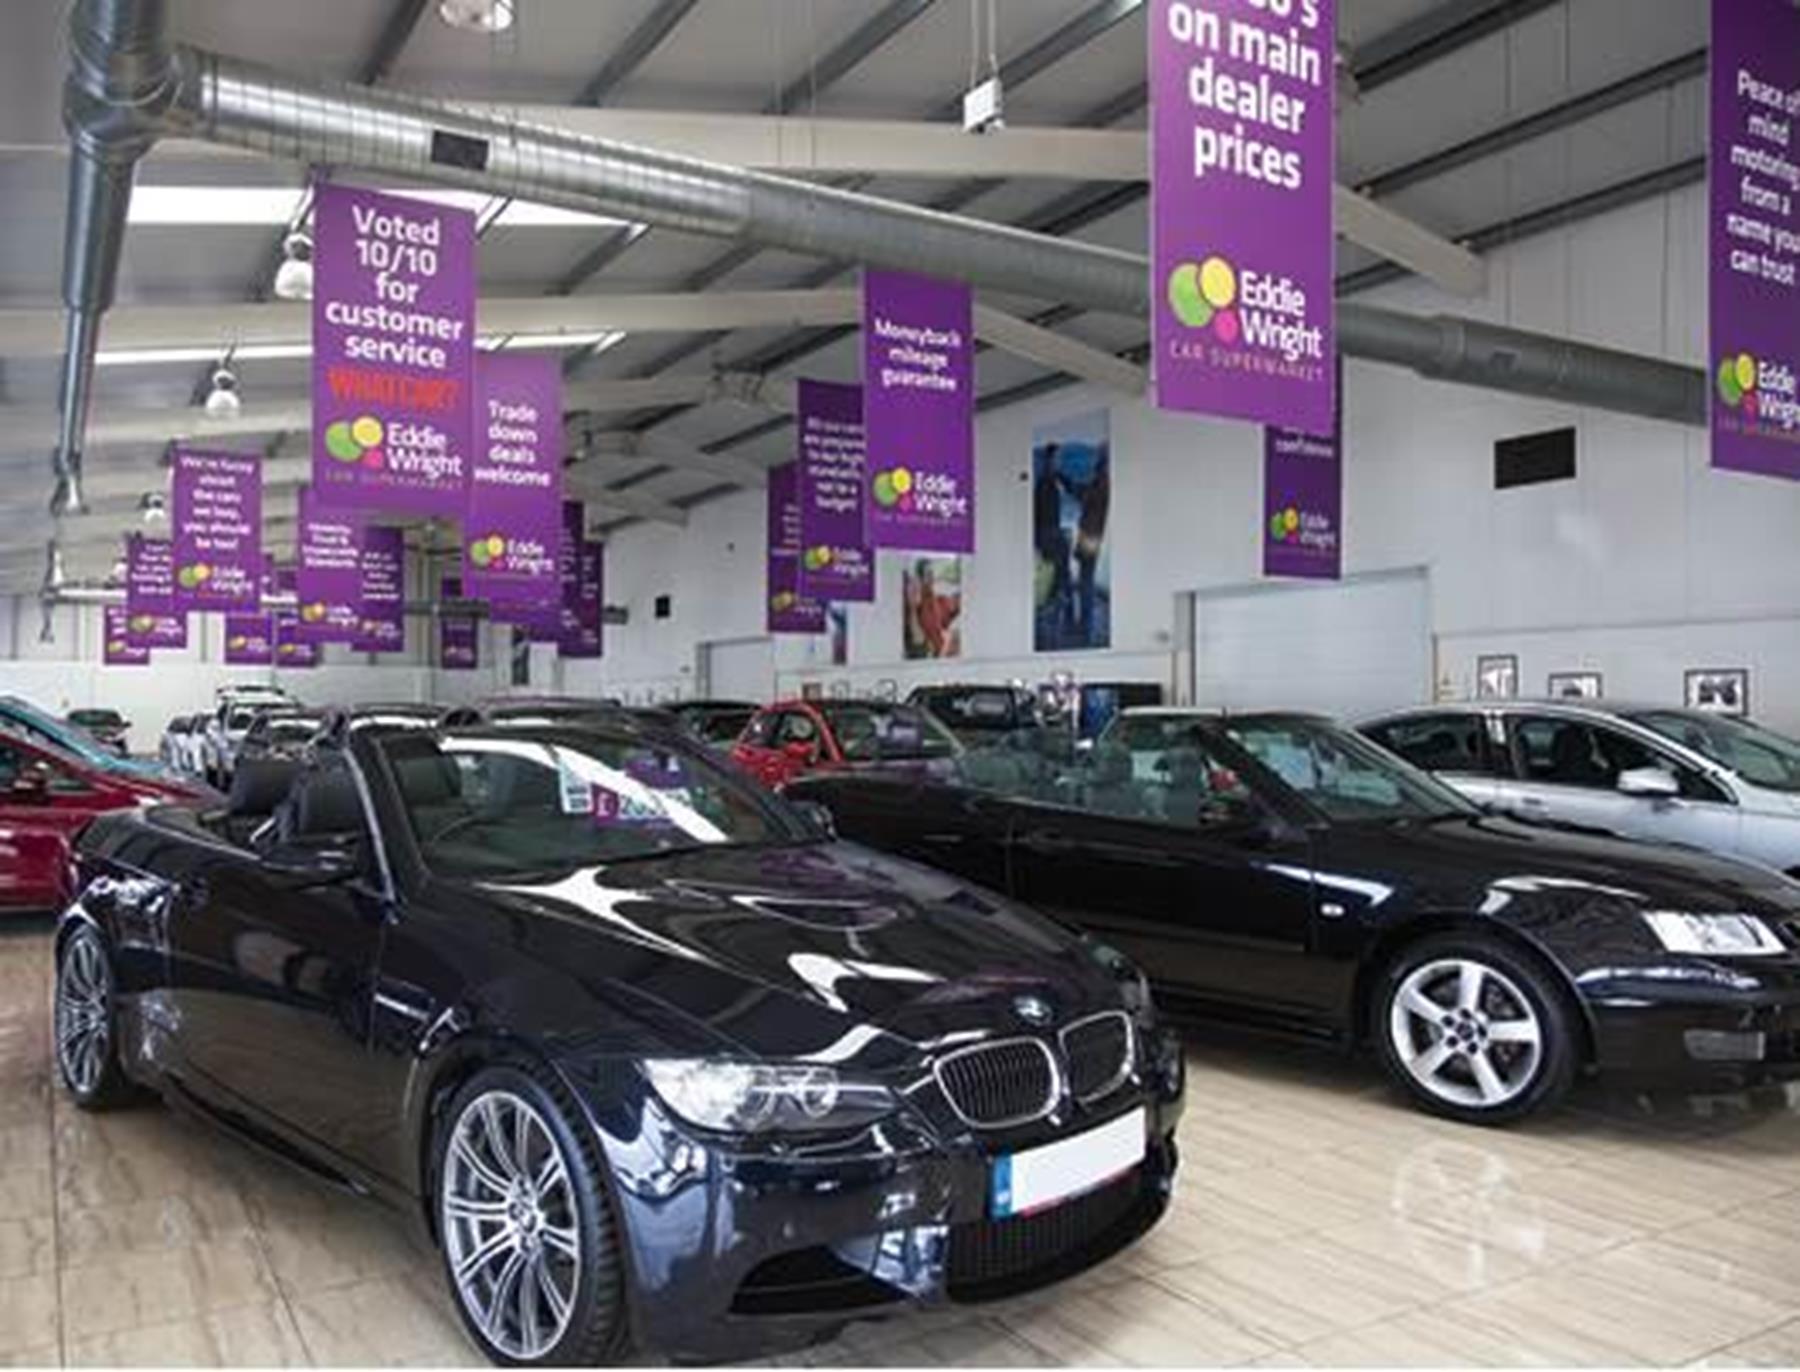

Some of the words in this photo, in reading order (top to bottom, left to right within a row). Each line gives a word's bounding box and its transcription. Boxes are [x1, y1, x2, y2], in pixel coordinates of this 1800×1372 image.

[1168, 2, 1219, 51] on
[1229, 19, 1321, 86] main
[1188, 55, 1305, 134] dealer
[1737, 69, 1783, 110] Peace
[1194, 122, 1302, 189] prices
[1741, 175, 1779, 211] from
[352, 205, 440, 246] Voted
[354, 239, 437, 277] 10/10
[376, 271, 419, 304] for
[1240, 269, 1305, 317] Eddie
[325, 302, 464, 341] customer
[1239, 307, 1323, 362] Wright
[345, 335, 447, 369] service
[487, 400, 538, 424] Trade
[386, 422, 447, 449] Eddie
[487, 422, 538, 444] down
[386, 447, 463, 480] Wright
[488, 445, 536, 466] deals
[473, 464, 551, 488] welcome
[915, 471, 955, 494] Eddie
[913, 493, 967, 518] Wright
